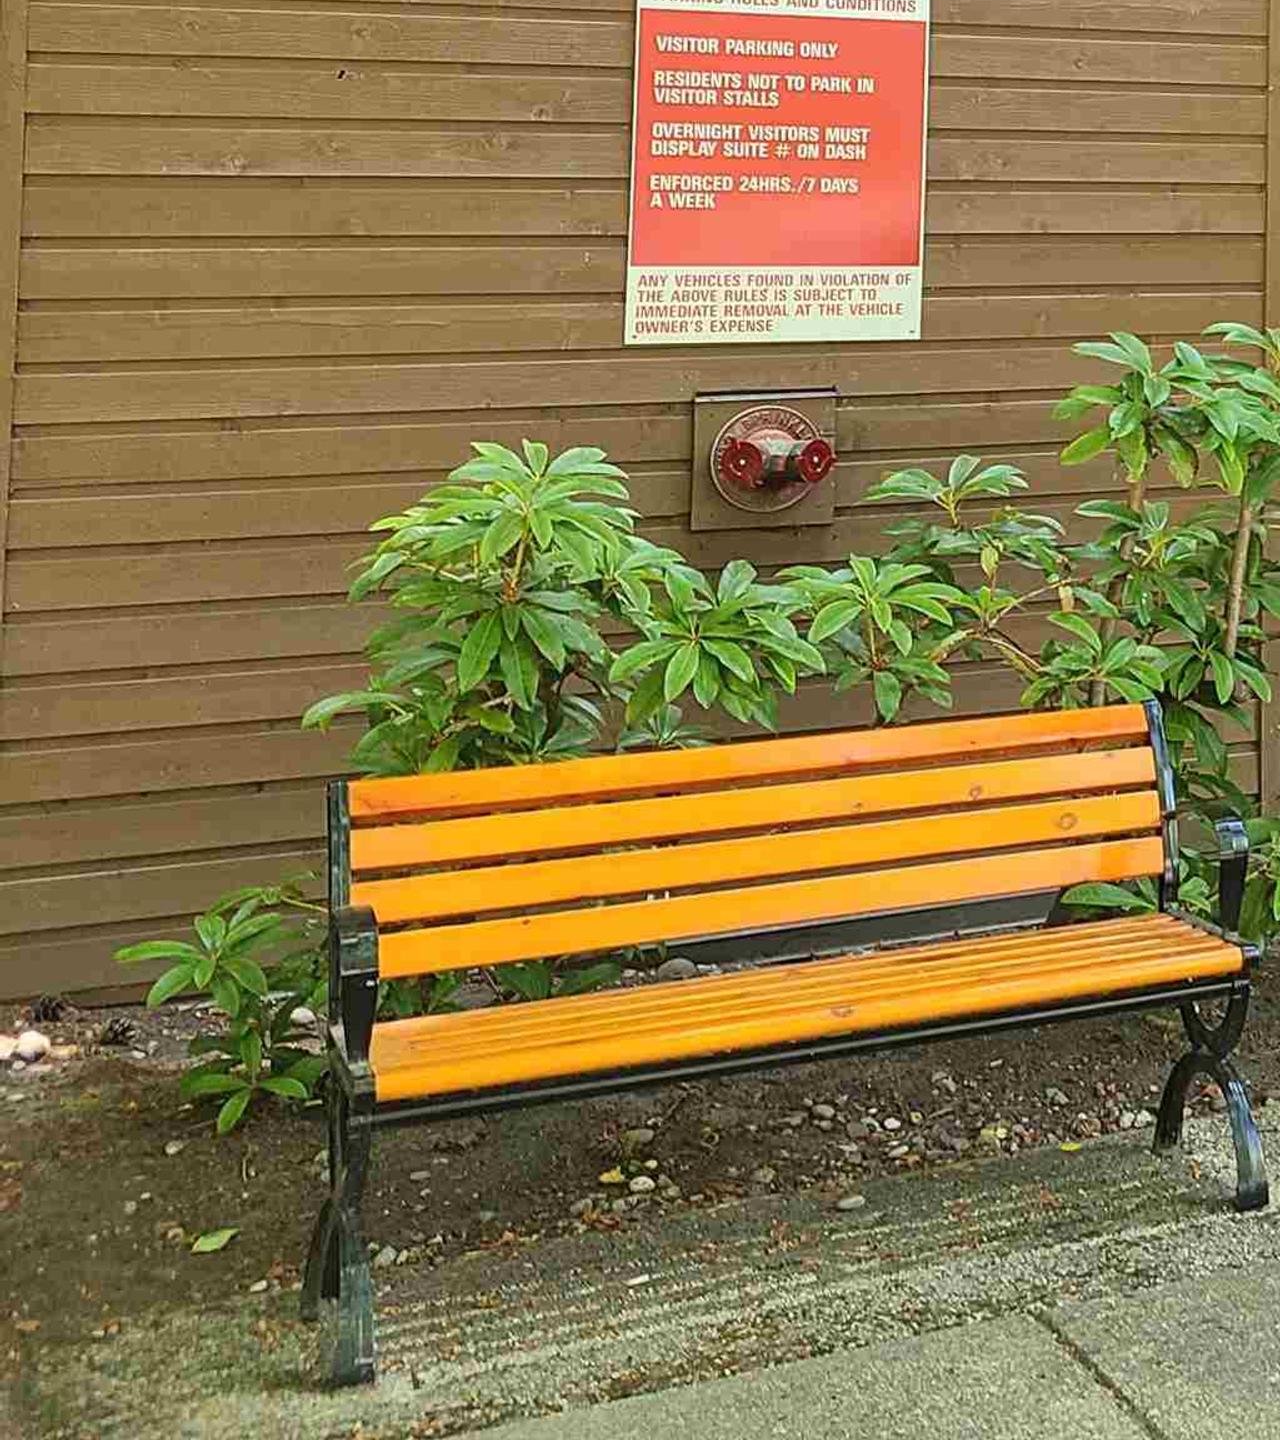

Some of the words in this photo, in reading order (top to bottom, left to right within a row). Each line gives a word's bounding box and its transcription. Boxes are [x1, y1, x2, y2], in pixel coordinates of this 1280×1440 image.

[656, 35, 719, 54] VISITOR
[725, 39, 794, 58] PARKING
[800, 42, 839, 59] ONLY
[654, 70, 742, 89] RESIDENTS
[748, 73, 780, 91] NOT
[785, 75, 805, 92] TO
[811, 76, 852, 93] PARK
[857, 78, 875, 94] IN
[654, 88, 718, 105] VISITOR
[723, 90, 780, 107] STALLS
[652, 122, 743, 140] OVERNIGHT
[749, 125, 820, 142] VISITORS
[825, 127, 871, 143] MUST
[651, 140, 718, 157] DISPLAY
[723, 142, 768, 158] SUITE
[774, 144, 792, 159] #
[797, 144, 820, 159] ON
[825, 145, 867, 160] DASH
[650, 174, 733, 192] ENFORCED
[820, 178, 859, 194] DAYS
[650, 192, 662, 208] A
[669, 193, 717, 210] WEEK
[638, 274, 668, 288] ANY
[675, 274, 741, 287] VEHICLES
[747, 274, 793, 287] FOUND
[800, 274, 814, 287] IN
[820, 273, 890, 287] VIOLATION
[895, 273, 912, 286] OF
[637, 289, 665, 303] THE
[671, 289, 718, 302] ABOVE
[724, 289, 768, 302] RULES
[774, 289, 787, 302] IS
[793, 288, 853, 302] SUBJECT
[860, 288, 877, 301] TO
[635, 305, 718, 318] IMMEDIATE
[723, 304, 789, 317] REMOVAL
[795, 304, 813, 316] AT
[818, 303, 843, 316] THE
[849, 303, 903, 316] VEHICLE
[635, 320, 703, 334] OWNER'S
[710, 319, 774, 333] EXPENSE
